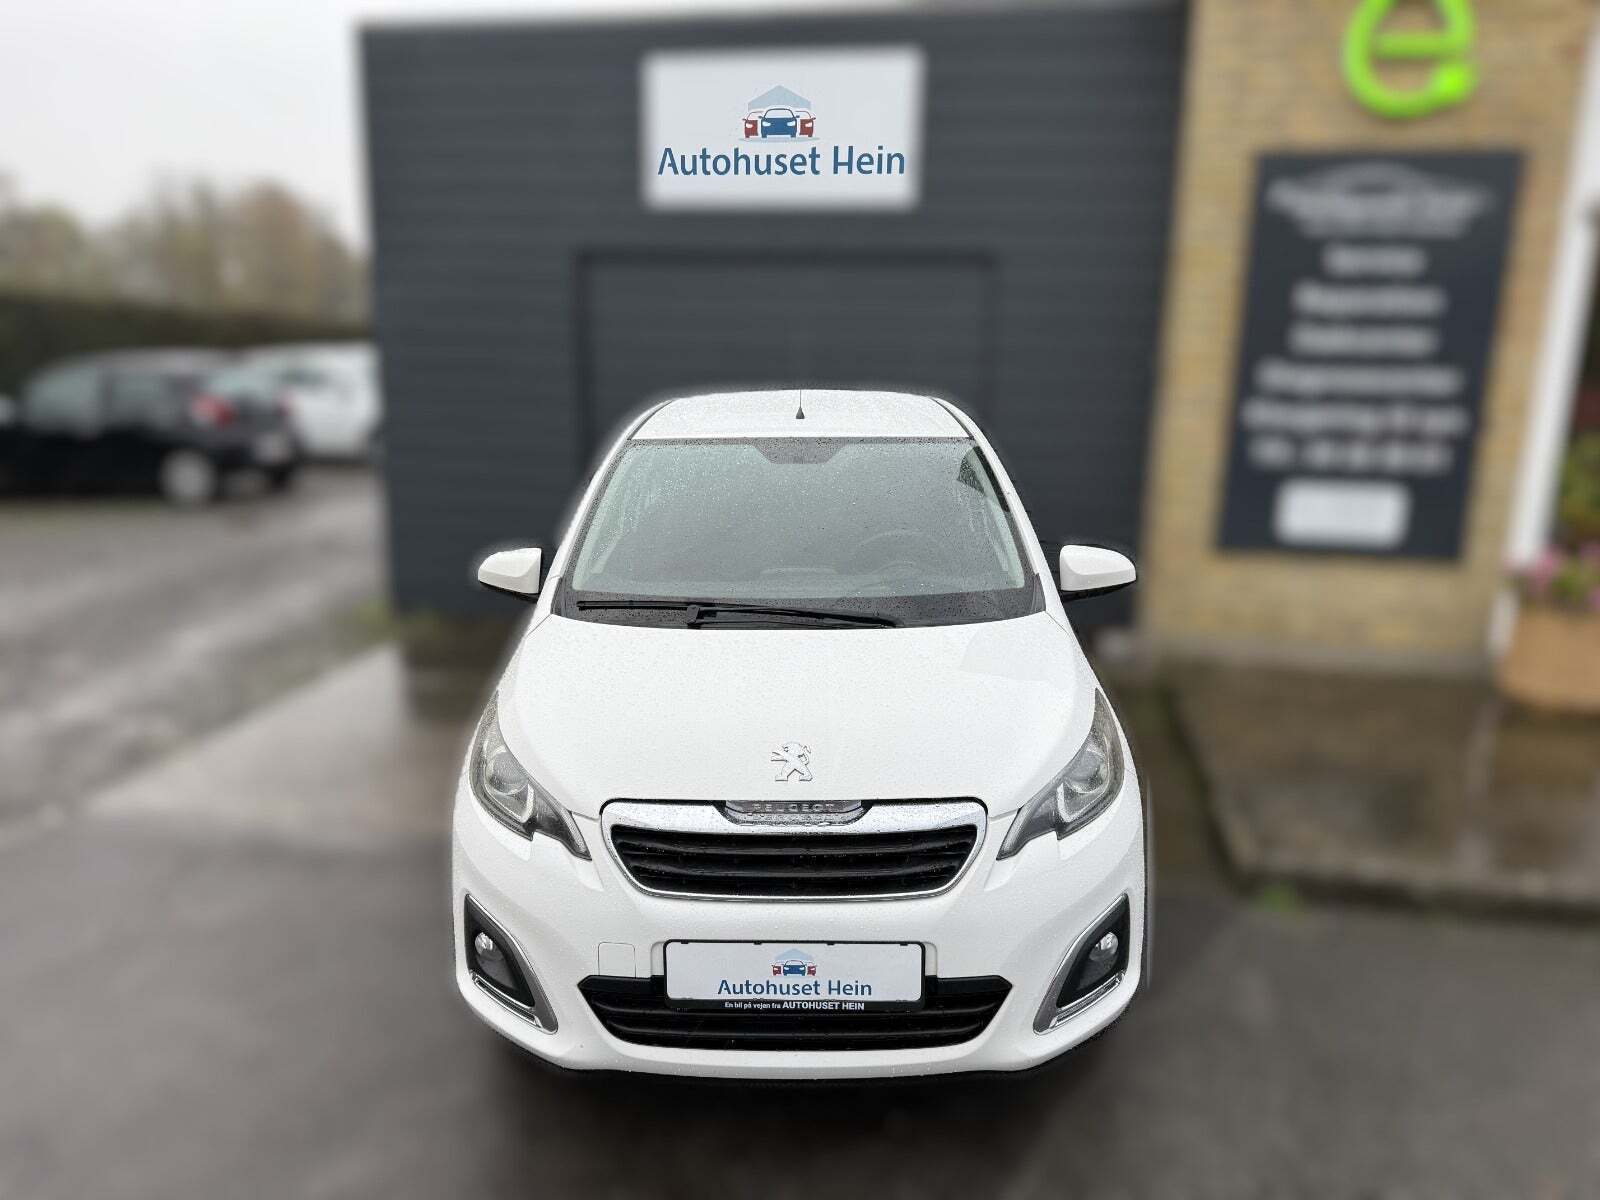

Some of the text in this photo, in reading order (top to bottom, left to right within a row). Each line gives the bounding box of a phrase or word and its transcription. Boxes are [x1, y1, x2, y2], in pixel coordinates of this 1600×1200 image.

[657, 145, 906, 176] Autohuset Hein
[717, 979, 872, 996] Autohuset Hein
[734, 1001, 743, 1009] bil
[743, 1002, 752, 1010] på
[753, 1002, 771, 1010] vejen
[782, 1001, 840, 1010] AUTOHUSET
[841, 1002, 865, 1011] HEIN
